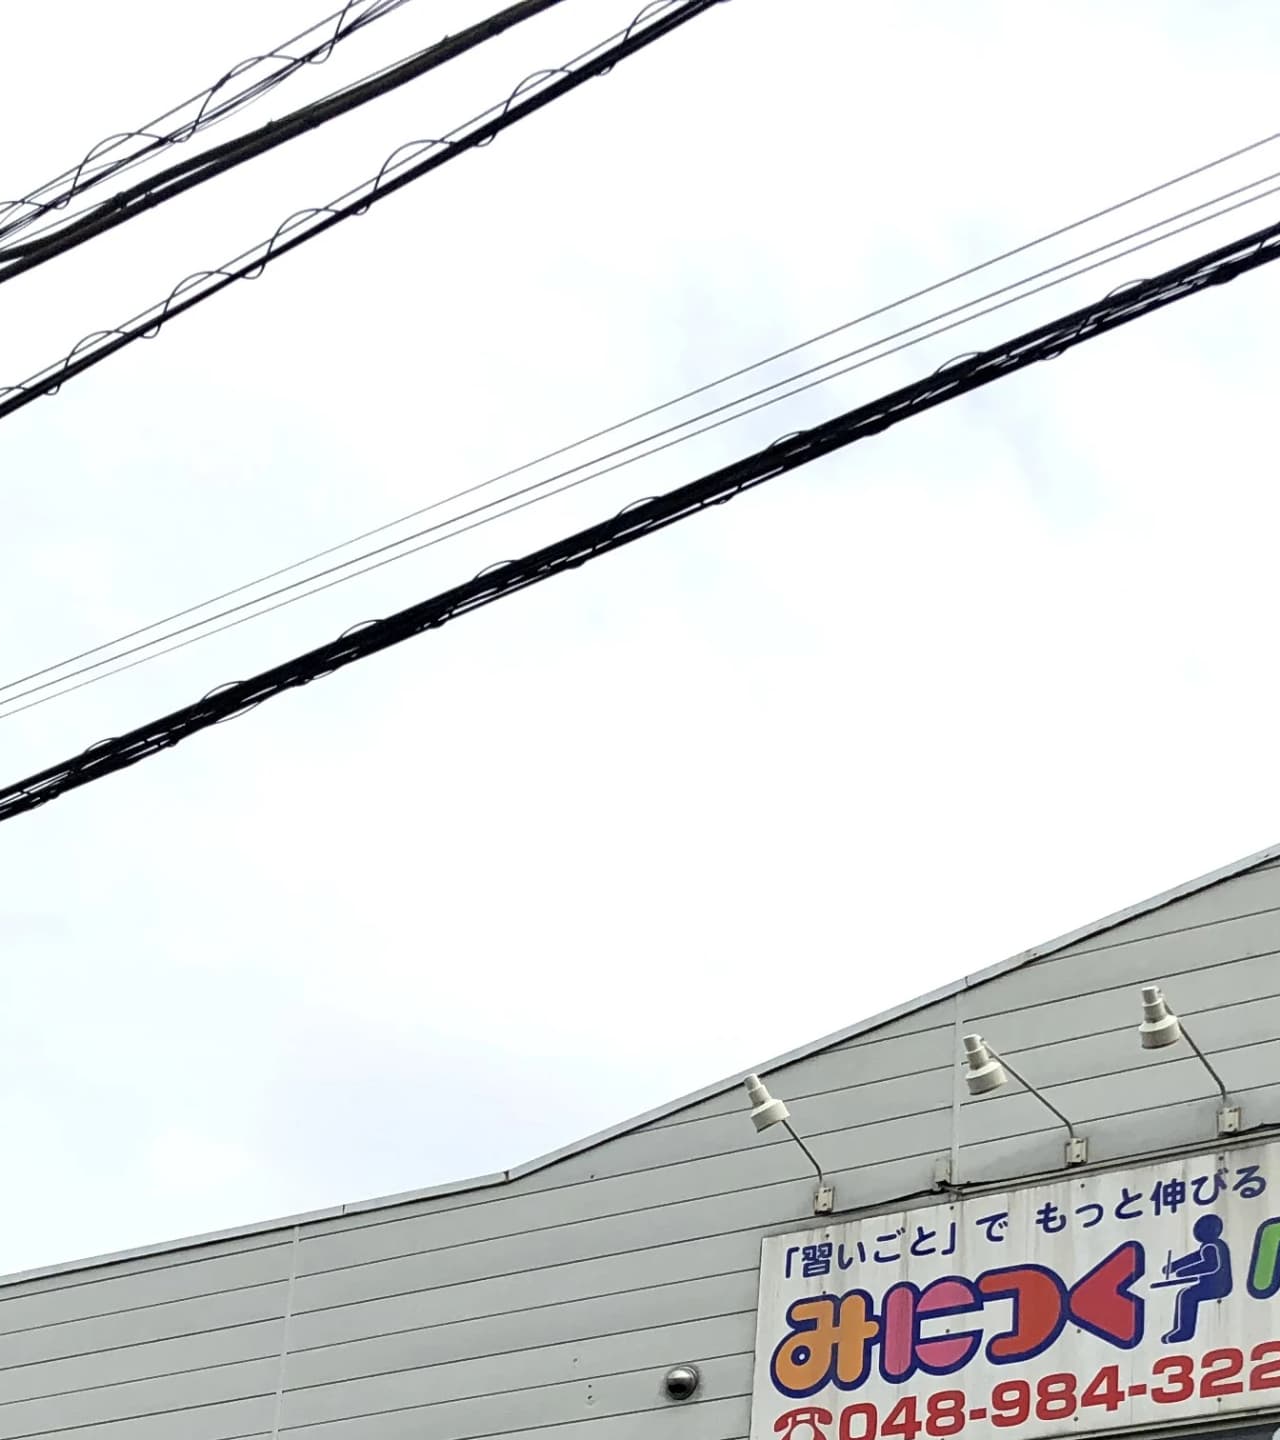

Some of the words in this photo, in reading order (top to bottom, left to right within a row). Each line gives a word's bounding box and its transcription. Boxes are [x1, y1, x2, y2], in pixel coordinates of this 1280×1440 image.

[1035, 1166, 1267, 1231] もっと伸びる
[771, 1240, 1146, 1399] みにつく
